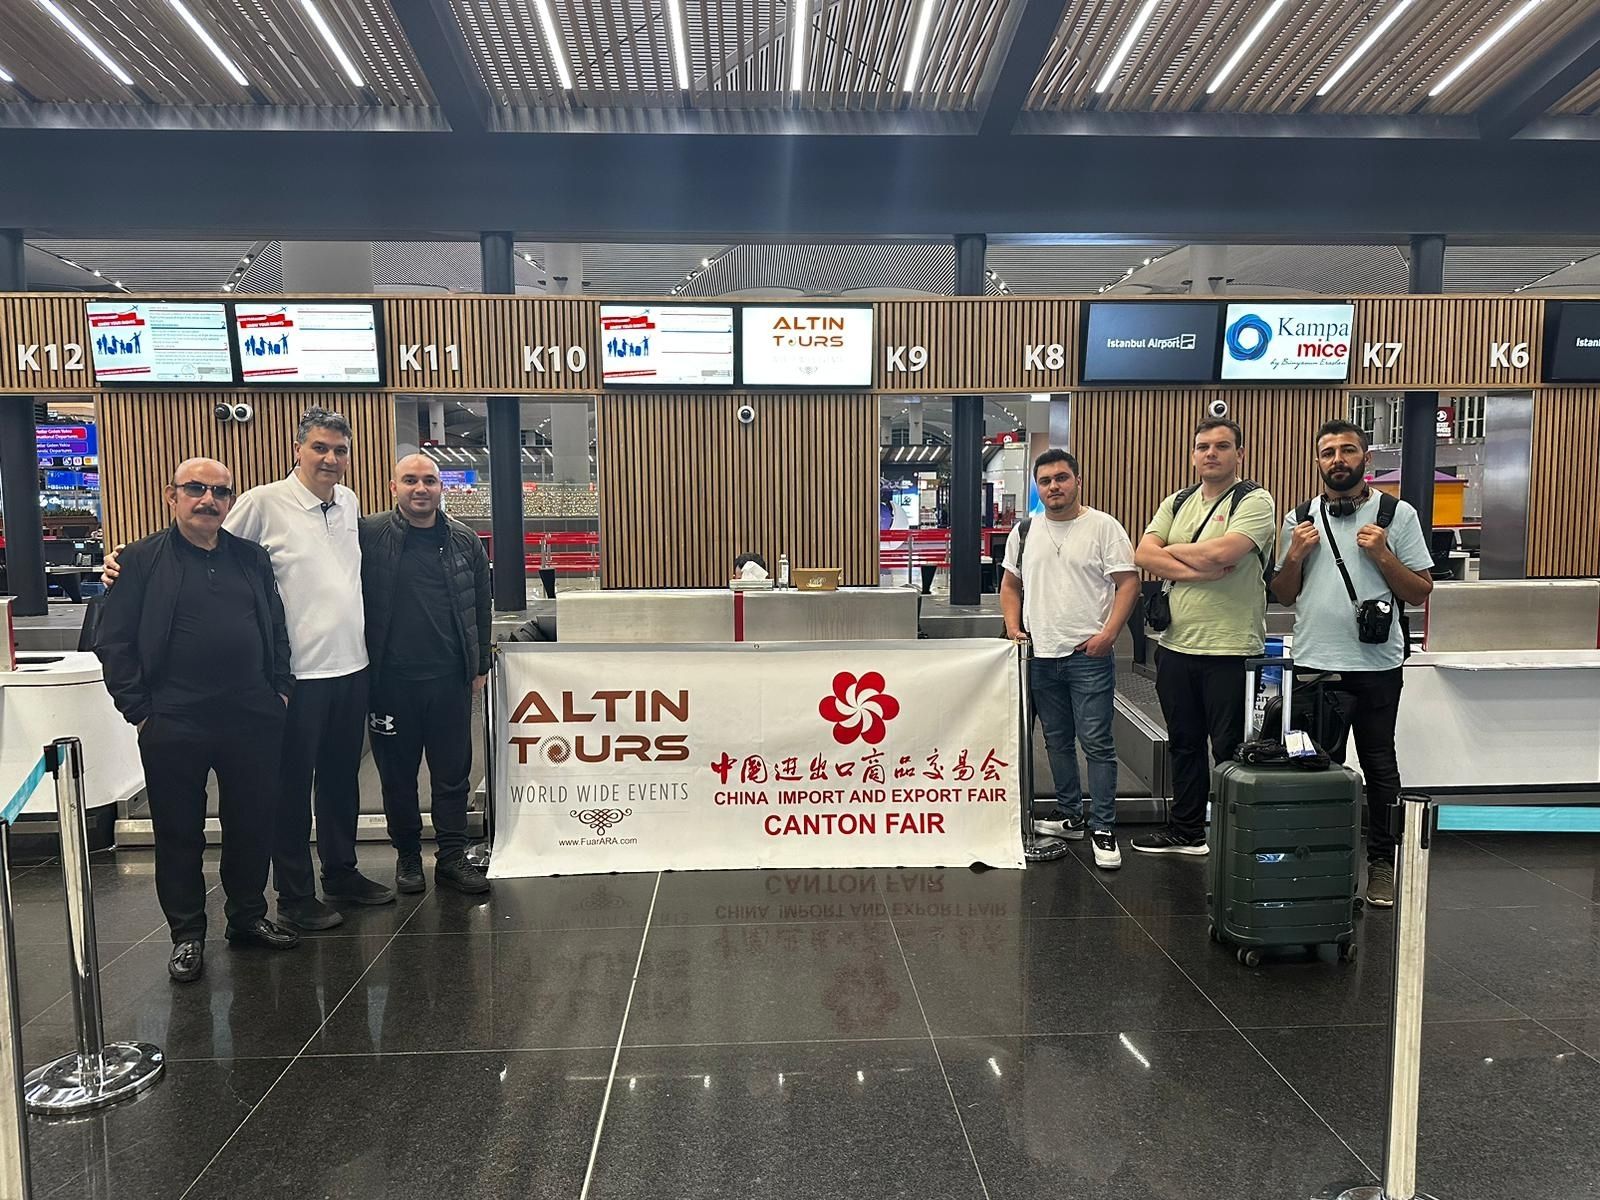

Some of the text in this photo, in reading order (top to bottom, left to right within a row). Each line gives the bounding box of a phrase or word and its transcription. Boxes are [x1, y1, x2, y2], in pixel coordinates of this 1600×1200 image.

[773, 317, 844, 330] ALTIN
[1278, 317, 1349, 341] Kampa
[773, 336, 844, 347] TOURS
[1107, 337, 1181, 350] Istanbul Airport
[1297, 338, 1348, 357] mice
[1576, 337, 1600, 347] Istan
[18, 343, 85, 371] K12
[400, 344, 460, 371] K11
[524, 345, 586, 373] K10
[887, 345, 928, 372] K9
[1025, 343, 1065, 371] K8
[1363, 342, 1403, 369] K7
[1490, 342, 1530, 369] K6
[508, 690, 689, 723] ALTIN
[508, 734, 690, 766] TOURS
[511, 783, 689, 803] WORLD WIDE EVENTS
[714, 788, 1008, 805] CHINA IMPORT AND EXPORT FAIR
[764, 812, 946, 836] CANTON FAIR
[558, 836, 638, 847] www.FuarARA.com
